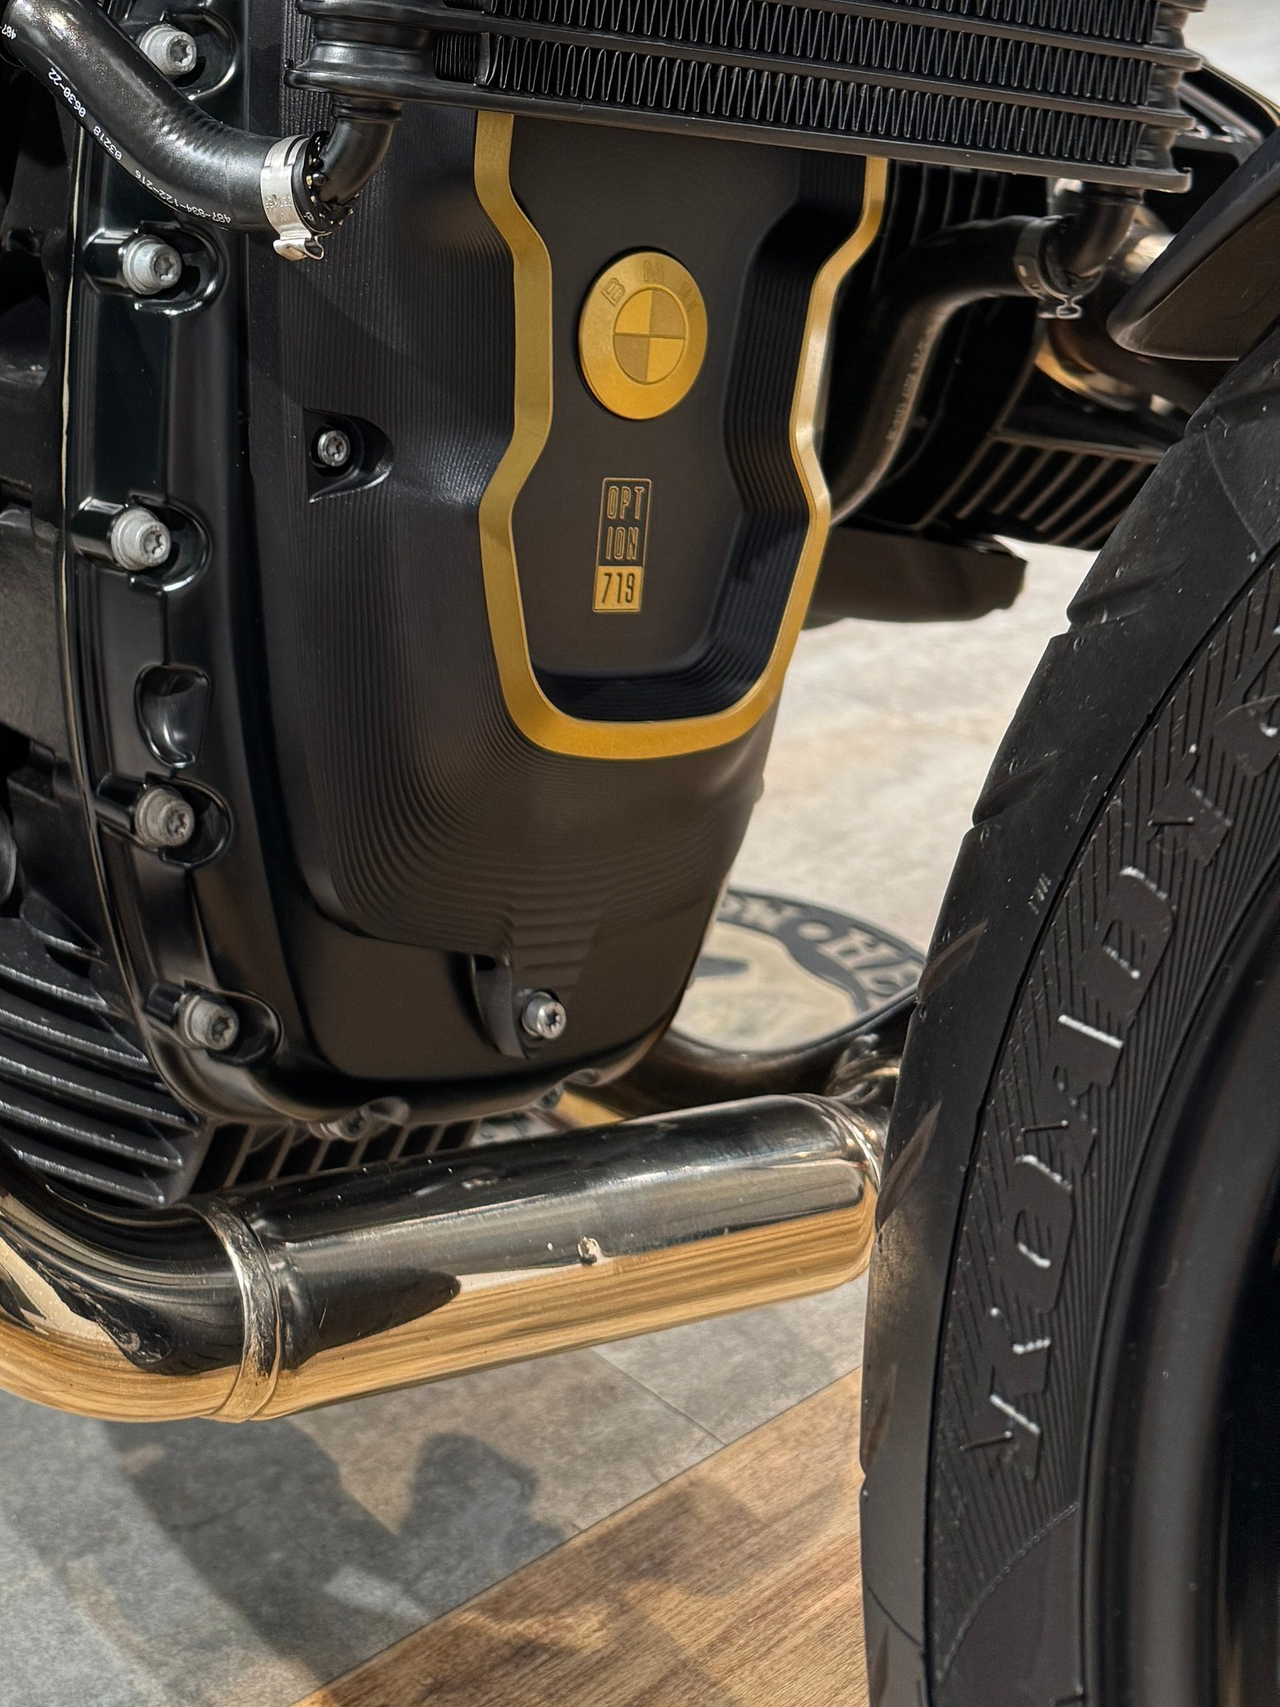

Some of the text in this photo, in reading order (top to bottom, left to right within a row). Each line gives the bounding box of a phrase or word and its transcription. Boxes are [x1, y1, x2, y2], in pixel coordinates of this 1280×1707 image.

[600, 259, 700, 312] BMW
[606, 485, 645, 520] OPT
[605, 526, 639, 561] ION
[601, 572, 636, 605] 719
